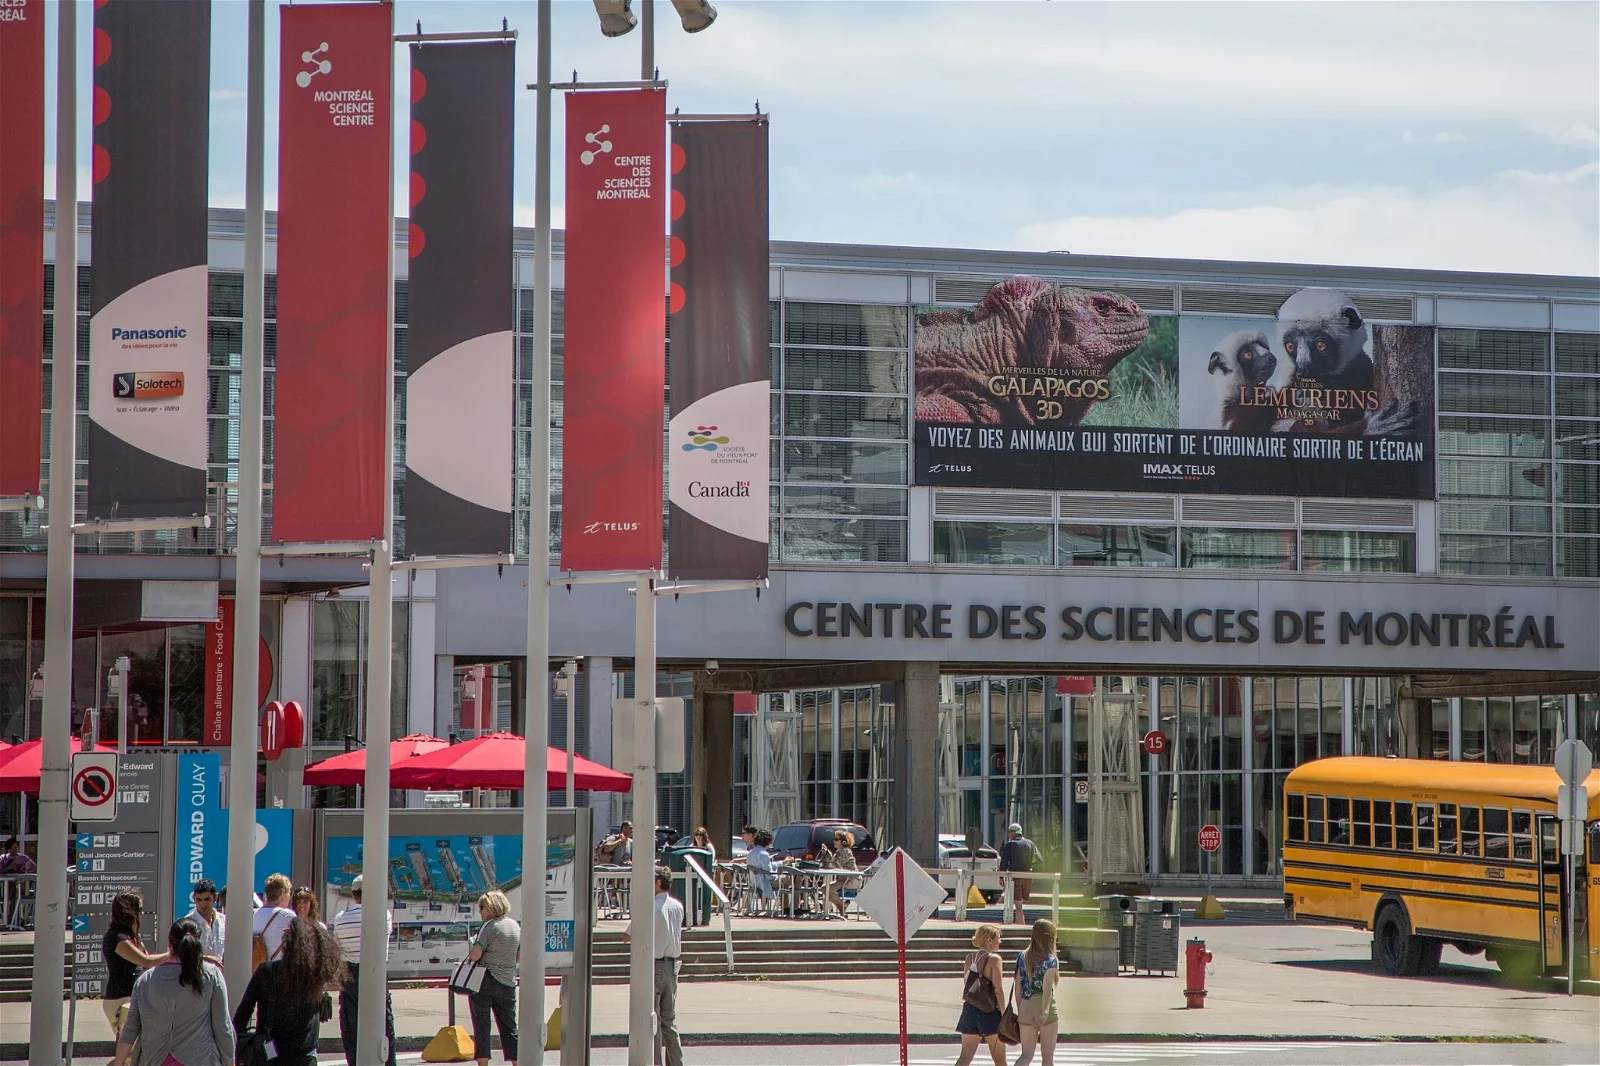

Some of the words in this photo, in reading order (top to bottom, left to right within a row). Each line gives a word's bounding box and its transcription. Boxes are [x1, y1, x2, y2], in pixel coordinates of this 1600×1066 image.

[314, 90, 374, 102] MONTRÉAL
[329, 103, 374, 114] SCIENCE
[333, 115, 374, 126] CENTRE
[614, 156, 651, 166] CENTRE
[632, 167, 651, 176] DES
[605, 178, 651, 188] SCIENCES
[597, 188, 650, 199] MONTRÉAL
[112, 326, 186, 340] Panasonic
[1002, 366, 1046, 376] MERVEILLES
[136, 378, 182, 390] Solotech
[988, 376, 1110, 400] GALAPAGOS
[1239, 381, 1379, 410] LÉMURIENS
[1036, 400, 1063, 420] 3D
[928, 426, 972, 448] VOYEZ
[979, 428, 1003, 449] DES
[1010, 430, 1075, 451] ANIMAUX
[1082, 432, 1106, 452] QUI
[1114, 433, 1173, 454] SORTENT
[1180, 435, 1196, 455] DE
[1204, 436, 1286, 458] L'ORDINAIRE
[1293, 438, 1341, 459] SORTIR
[1348, 440, 1363, 460] DE
[1370, 439, 1423, 462] L'ÉCRAN
[1143, 464, 1183, 474] IMAX
[1184, 464, 1215, 475] TELUS
[688, 481, 750, 498] Canada
[785, 602, 952, 638] CENTRE
[969, 604, 1046, 640] DES
[1061, 606, 1260, 643] SCIENCES
[1274, 610, 1326, 644] DE
[1340, 606, 1564, 649] MONTRÉAL
[215, 633, 223, 654] Food
[214, 662, 223, 709] alimentaire
[213, 711, 222, 741] Chaîne
[1148, 737, 1163, 748] 15
[192, 763, 205, 806] QUAY
[190, 811, 204, 883] EDWARD
